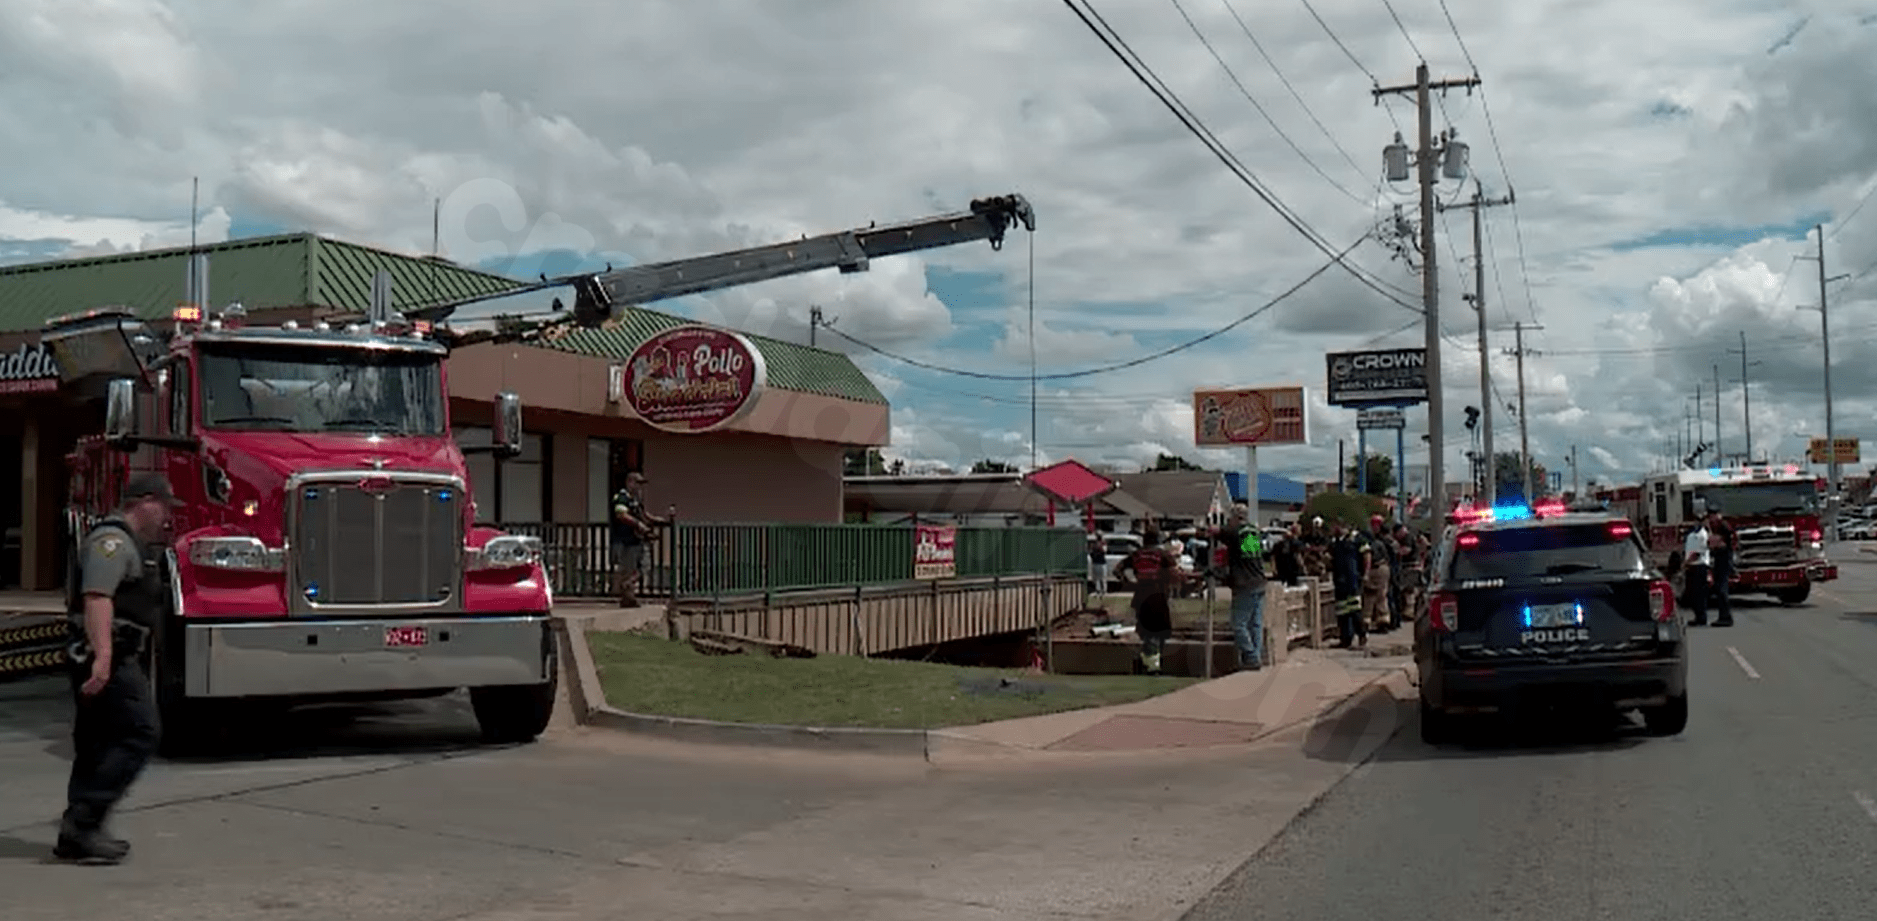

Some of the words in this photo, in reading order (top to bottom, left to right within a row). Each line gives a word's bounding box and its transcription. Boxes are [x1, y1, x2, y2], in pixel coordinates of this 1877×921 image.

[693, 344, 744, 377] Pollo
[1353, 352, 1425, 369] CROWN
[1521, 628, 1591, 645] POLICE
